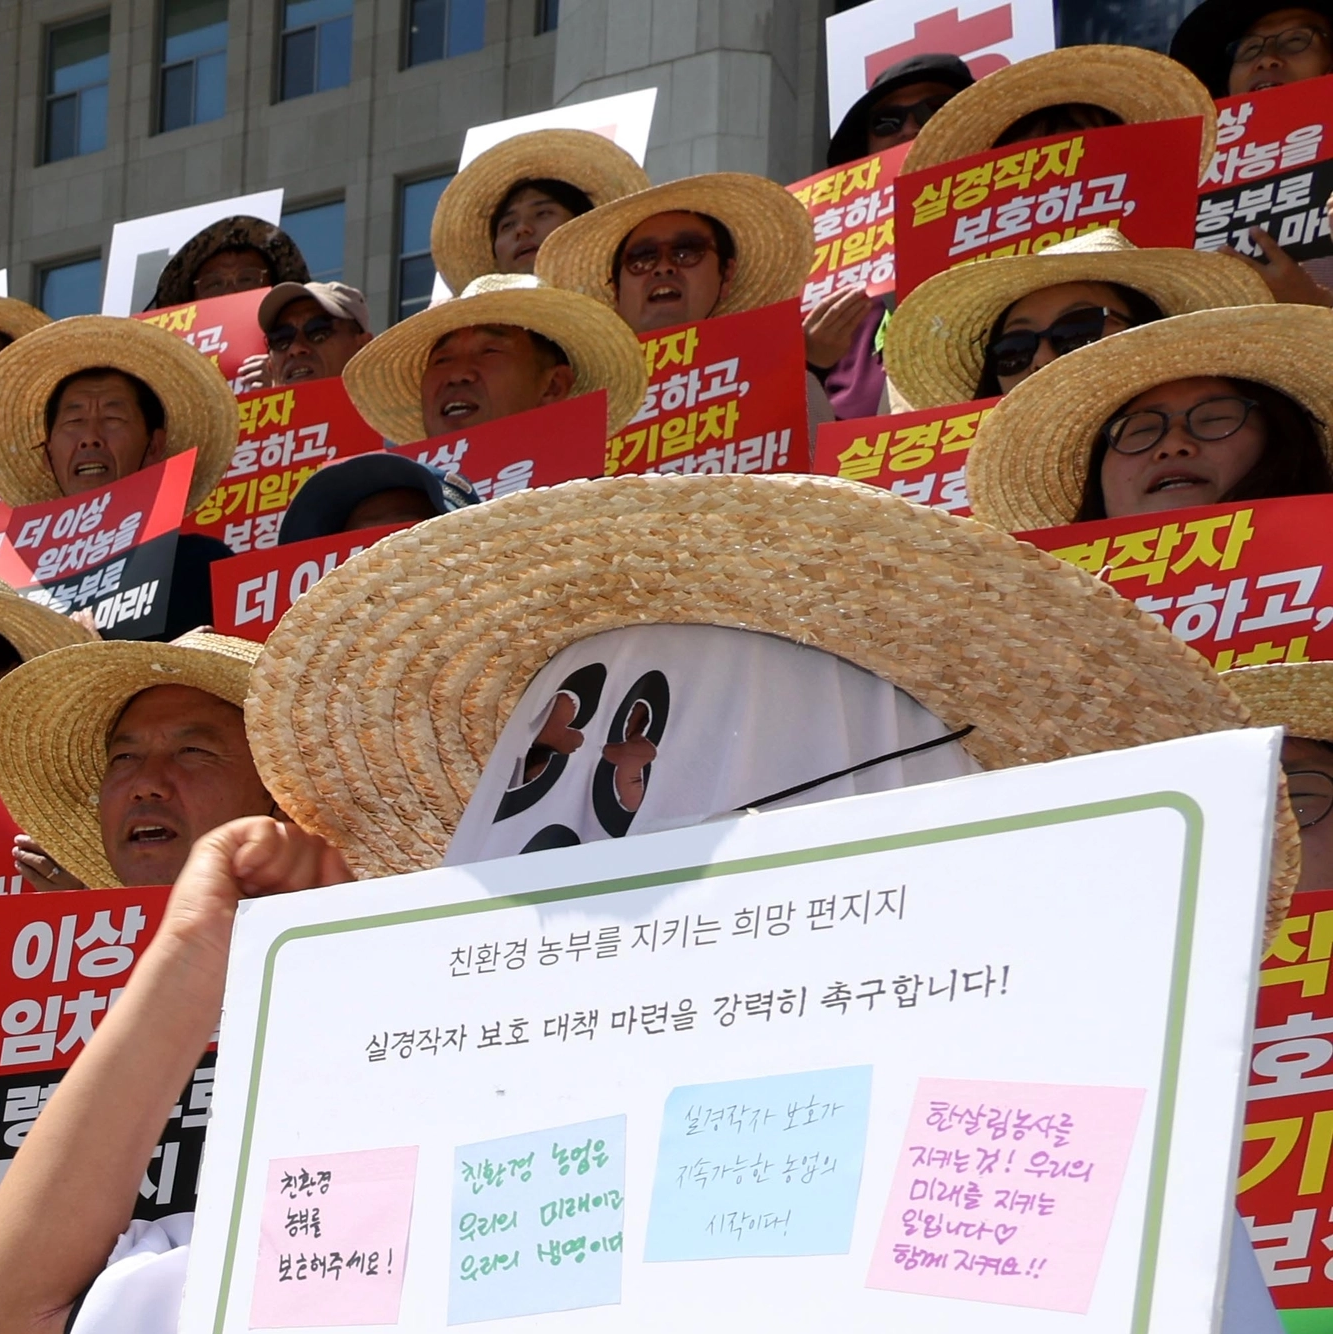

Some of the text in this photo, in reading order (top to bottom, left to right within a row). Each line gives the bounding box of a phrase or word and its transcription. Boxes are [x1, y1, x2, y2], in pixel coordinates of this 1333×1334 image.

[912, 137, 1086, 227] 실경작자
[949, 173, 1136, 257] 보호하고,
[14, 492, 112, 548] 더 이상
[30, 512, 142, 582] 임차농을
[95, 580, 159, 629] 마라!
[235, 569, 278, 626] 더
[10, 905, 147, 982] 이상
[447, 884, 907, 977] 친환경 농부를 지키는 희망 편지지
[365, 964, 1013, 1063] 실경작자 보호 대책 마련을 강력히 촉구합니다!
[684, 1095, 846, 1136] 실경작자 보호가
[280, 1169, 332, 1197] 친환경
[676, 1155, 838, 1190] 지속가능한 농업의
[1024, 1153, 1094, 1183] 우리의
[910, 1178, 1057, 1217] 미래를 지키는
[284, 1208, 323, 1237] 농부를
[705, 1210, 793, 1237] 시작이다!
[892, 1244, 949, 1273] 함께
